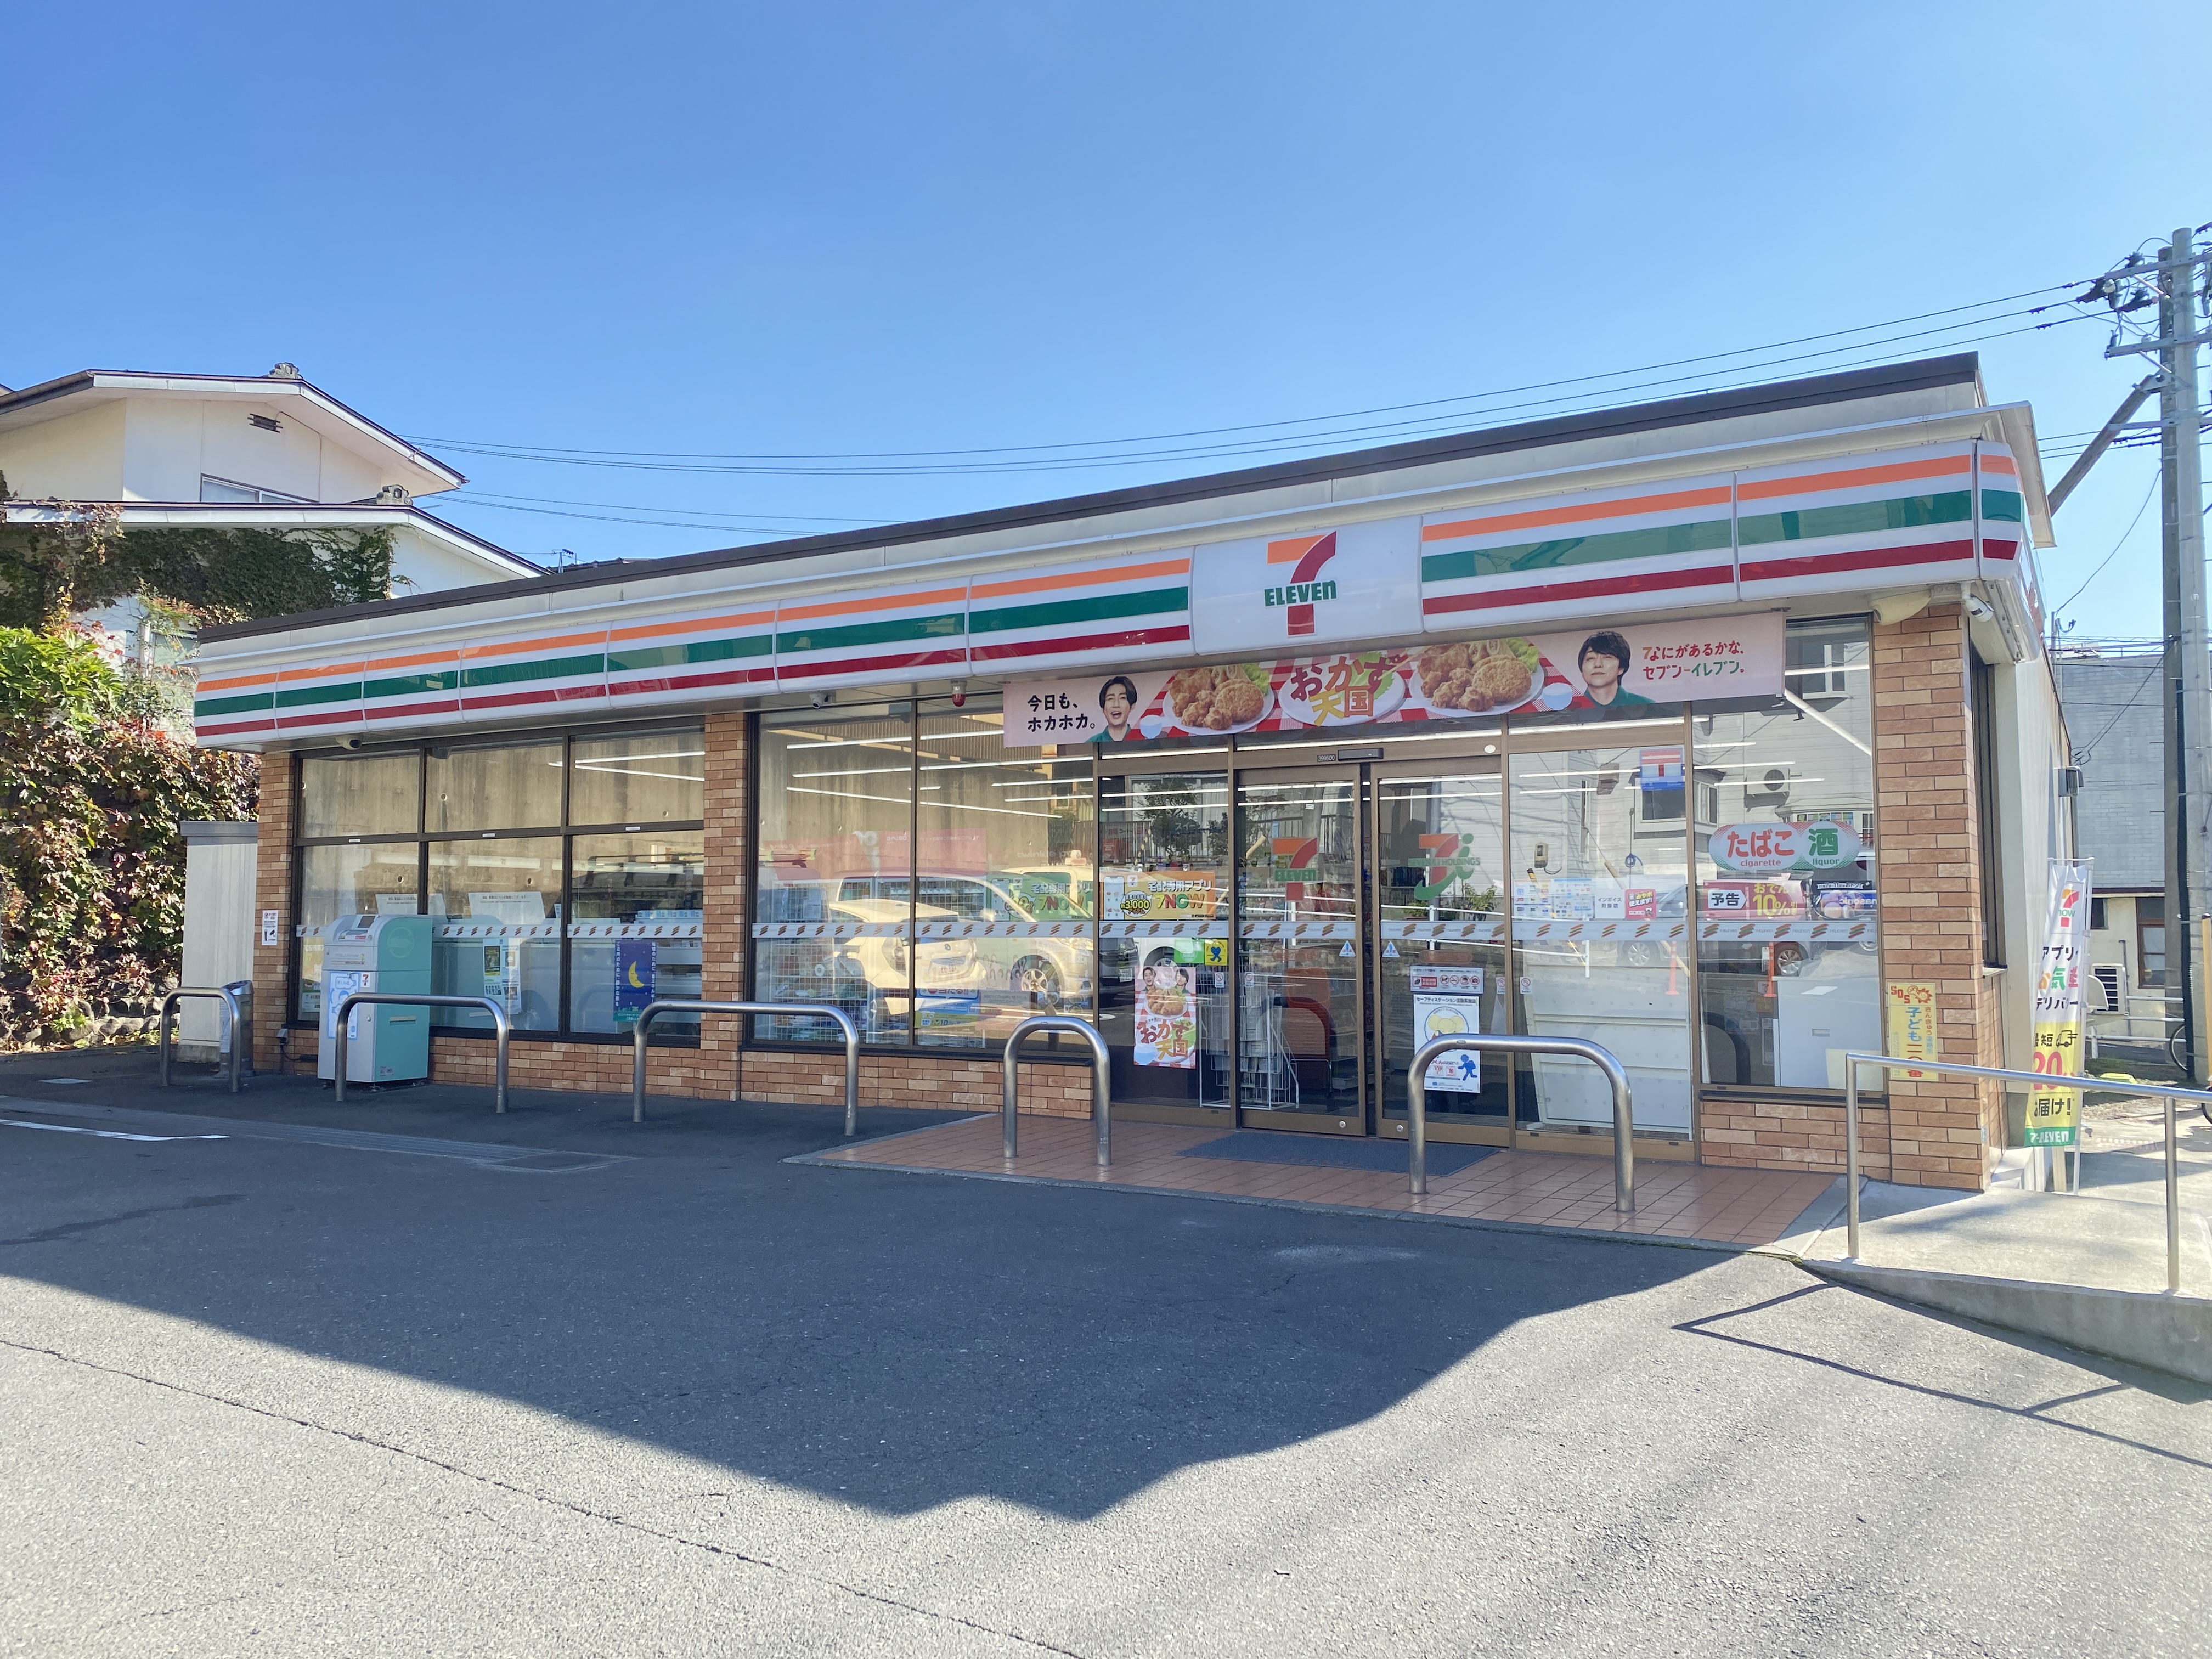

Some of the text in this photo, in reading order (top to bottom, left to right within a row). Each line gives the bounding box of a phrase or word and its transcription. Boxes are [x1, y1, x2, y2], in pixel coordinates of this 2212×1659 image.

[1291, 654, 1407, 700] おかず
[1027, 694, 1079, 713] 今日も、
[1312, 686, 1374, 727] 天国
[1027, 713, 1096, 733] ホカホカ。
[1727, 828, 1838, 857] たばこ 酒
[1740, 857, 1840, 868] cigarette liquor
[1148, 879, 1212, 893] 宅配専用アプリ
[1155, 893, 1205, 909] 7NOW
[1711, 893, 1740, 906] 予告
[2042, 945, 2079, 961] アプリ
[1891, 986, 1910, 1004] SOS
[1138, 1019, 1191, 1044] おかず
[1155, 1039, 1189, 1060] 天国
